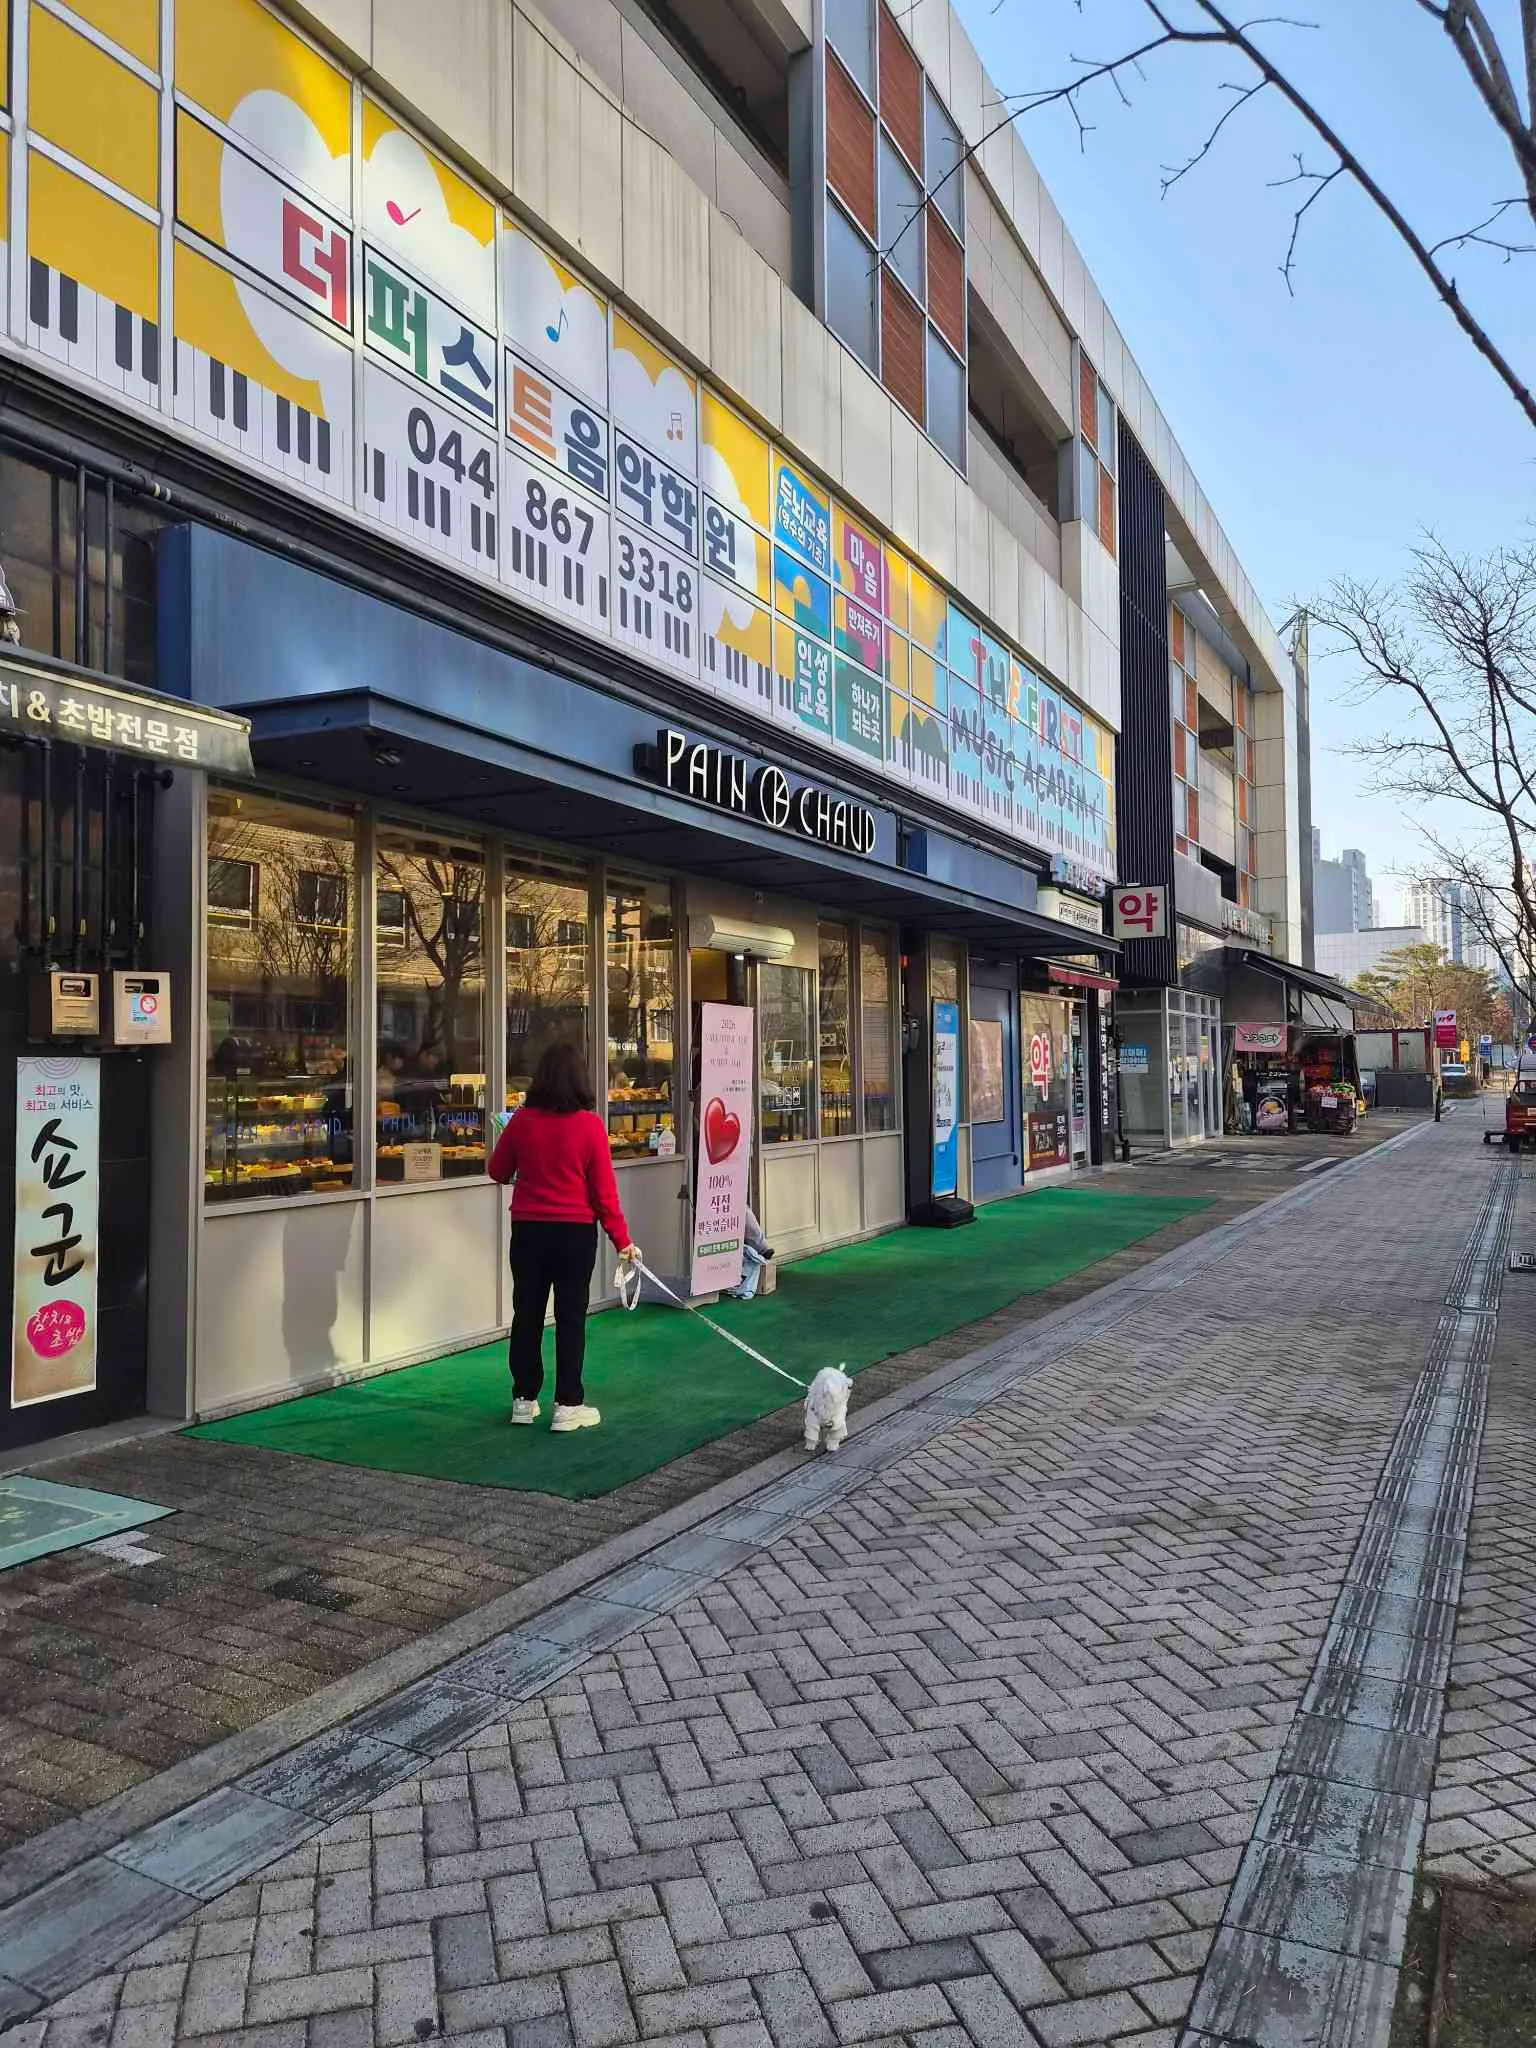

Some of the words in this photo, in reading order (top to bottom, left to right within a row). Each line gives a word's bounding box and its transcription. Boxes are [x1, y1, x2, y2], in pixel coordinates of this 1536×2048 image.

[407, 406, 495, 500] 044
[525, 478, 594, 556] 867
[618, 534, 693, 614] 3318
[850, 532, 879, 599] 마음
[26, 690, 52, 724] &
[56, 697, 199, 761] 초밥전문점
[851, 681, 880, 717] 하나가
[969, 637, 1022, 724] THE
[1026, 683, 1081, 768] FIRST
[667, 729, 747, 813] PAIN
[800, 787, 876, 854] CHAUD
[951, 705, 1016, 793] MUSIC
[1023, 750, 1100, 834] ACADEMY
[1119, 893, 1159, 933] 약
[35, 1084, 65, 1096] 최고의
[1030, 1032, 1050, 1102] 약
[25, 1100, 56, 1112] 최고의
[60, 1099, 94, 1112] 서비스
[708, 1174, 733, 1190] 100%
